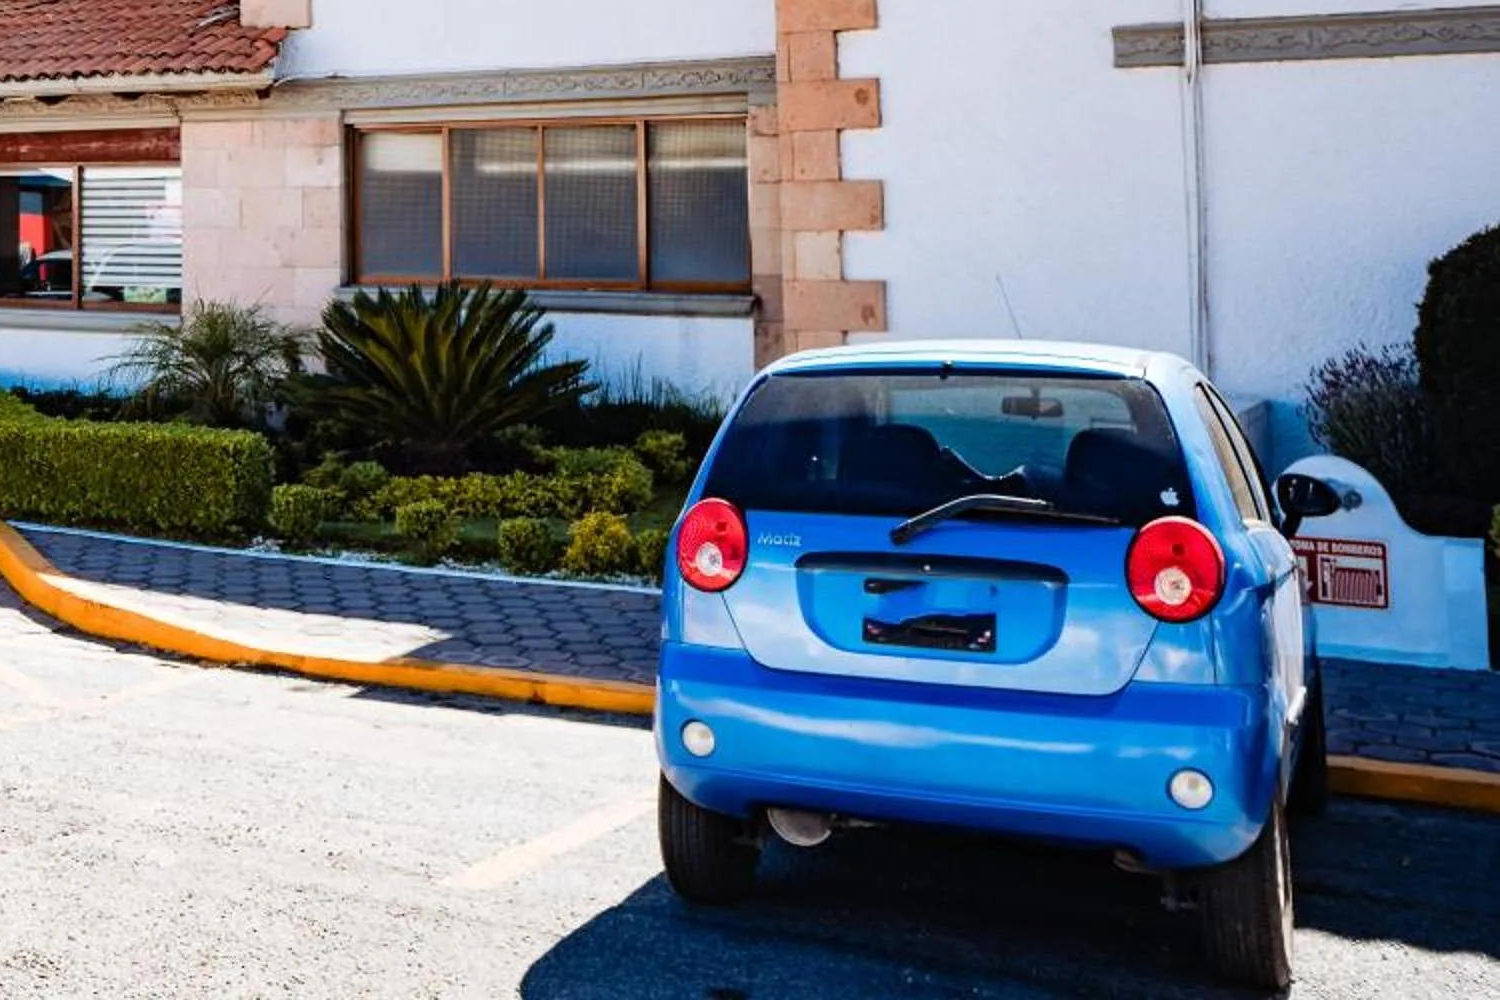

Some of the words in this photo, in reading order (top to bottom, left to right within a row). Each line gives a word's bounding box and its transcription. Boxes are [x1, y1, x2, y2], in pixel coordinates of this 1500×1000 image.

[757, 532, 802, 547] Matiz
[1317, 542, 1330, 552] DE
[1332, 543, 1383, 556] BOMBEROS
